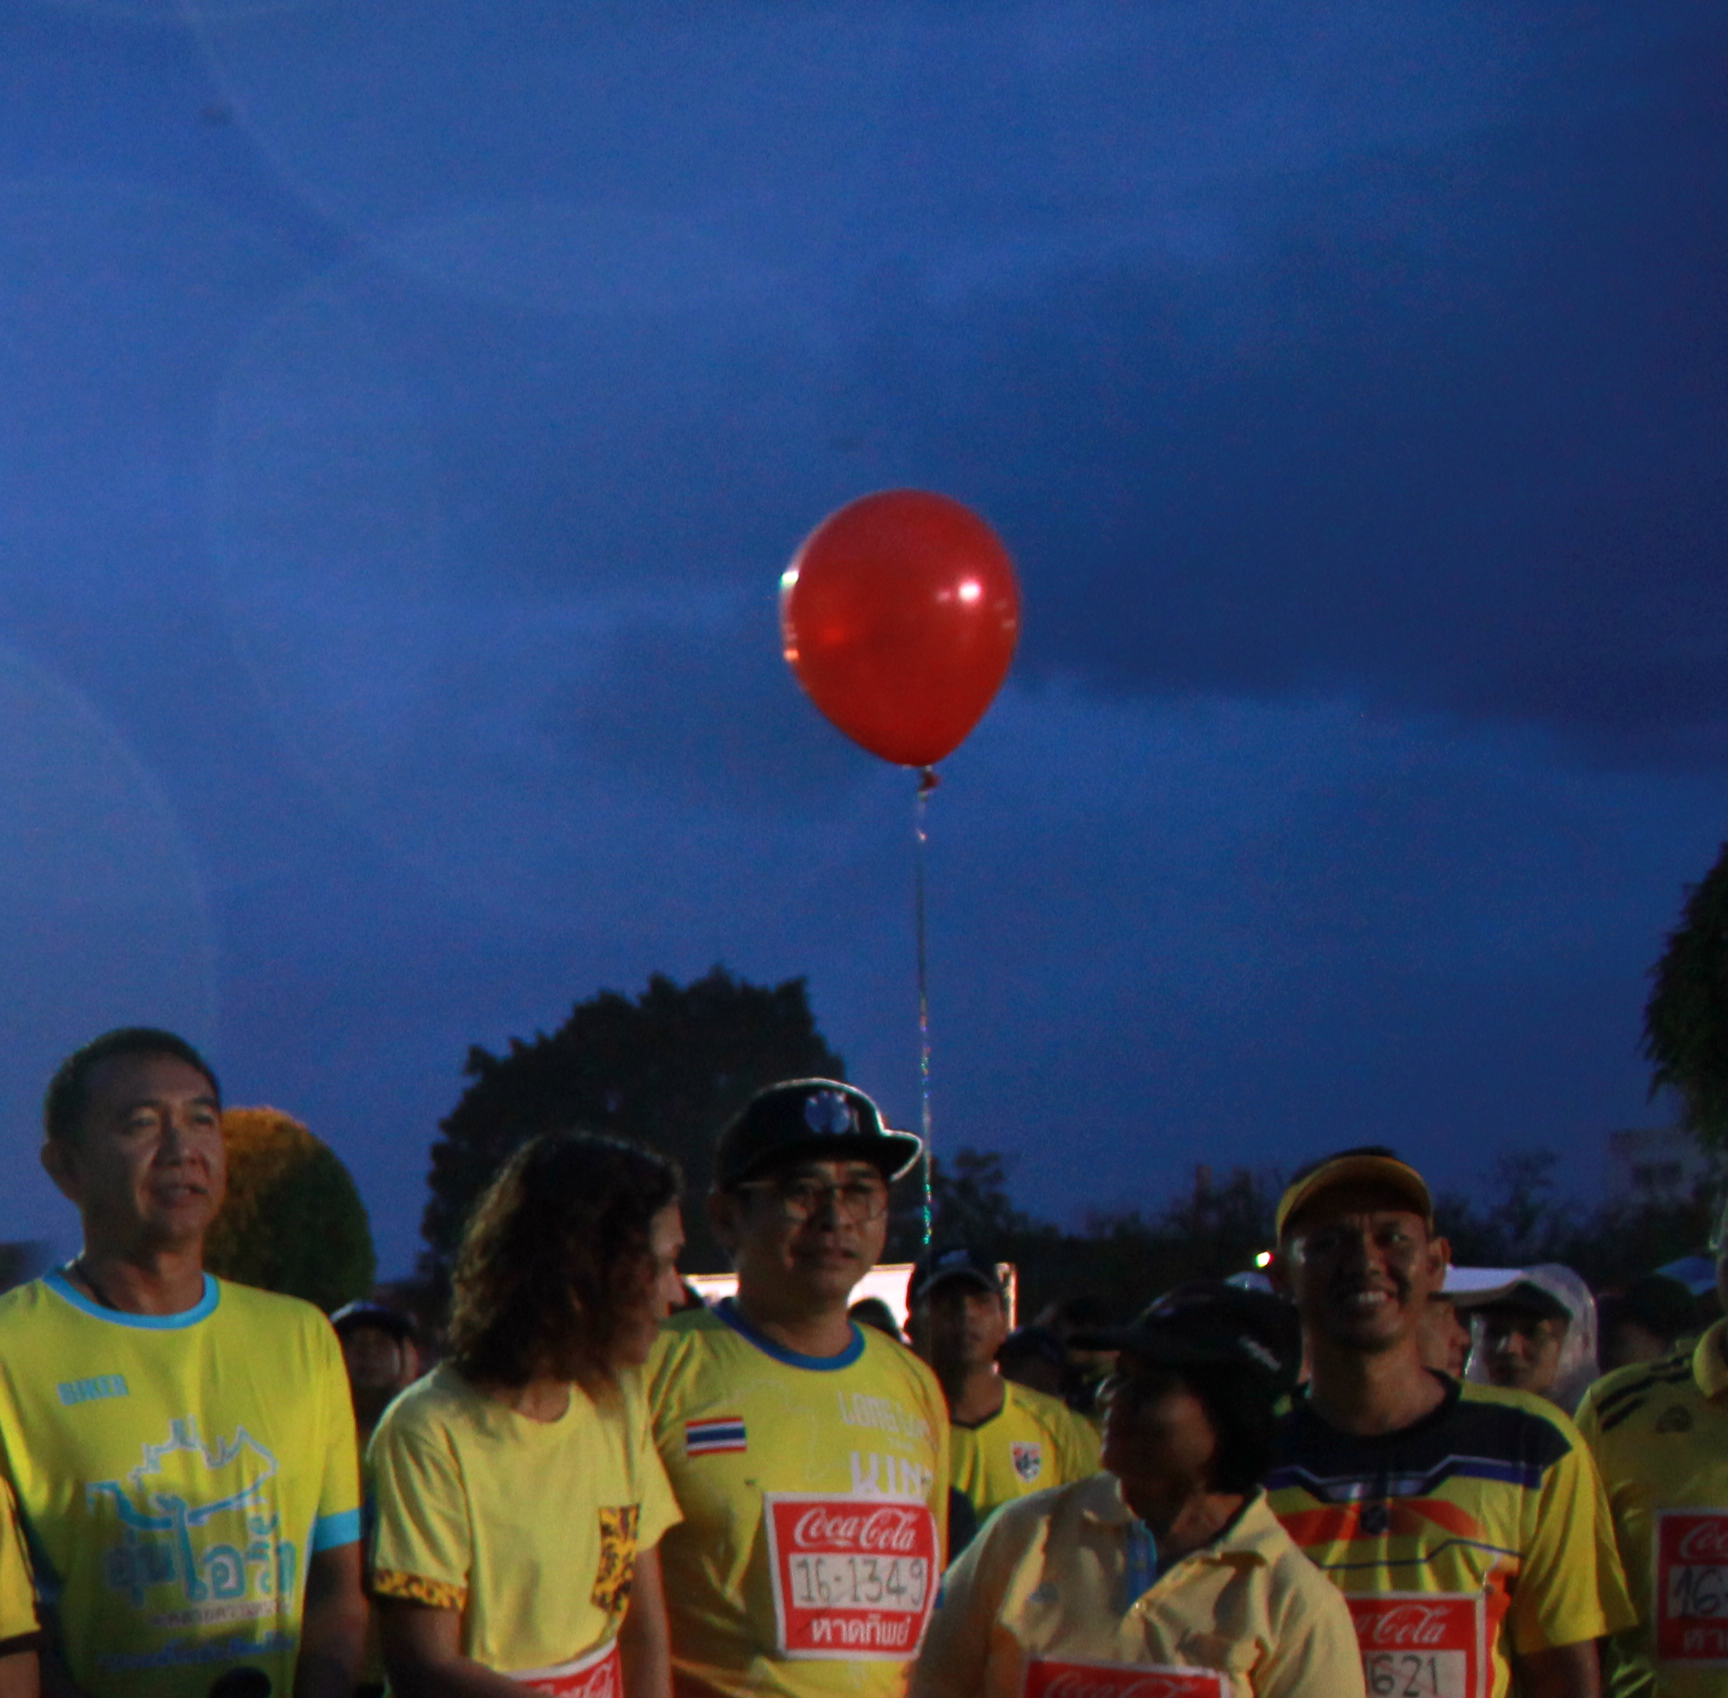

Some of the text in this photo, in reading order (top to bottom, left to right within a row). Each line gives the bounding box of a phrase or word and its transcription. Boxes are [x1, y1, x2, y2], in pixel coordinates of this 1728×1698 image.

[793, 1506, 918, 1552] Coca-Cola
[809, 1613, 912, 1647] หาดทิพย์
[1355, 1603, 1454, 1645] a-Cola
